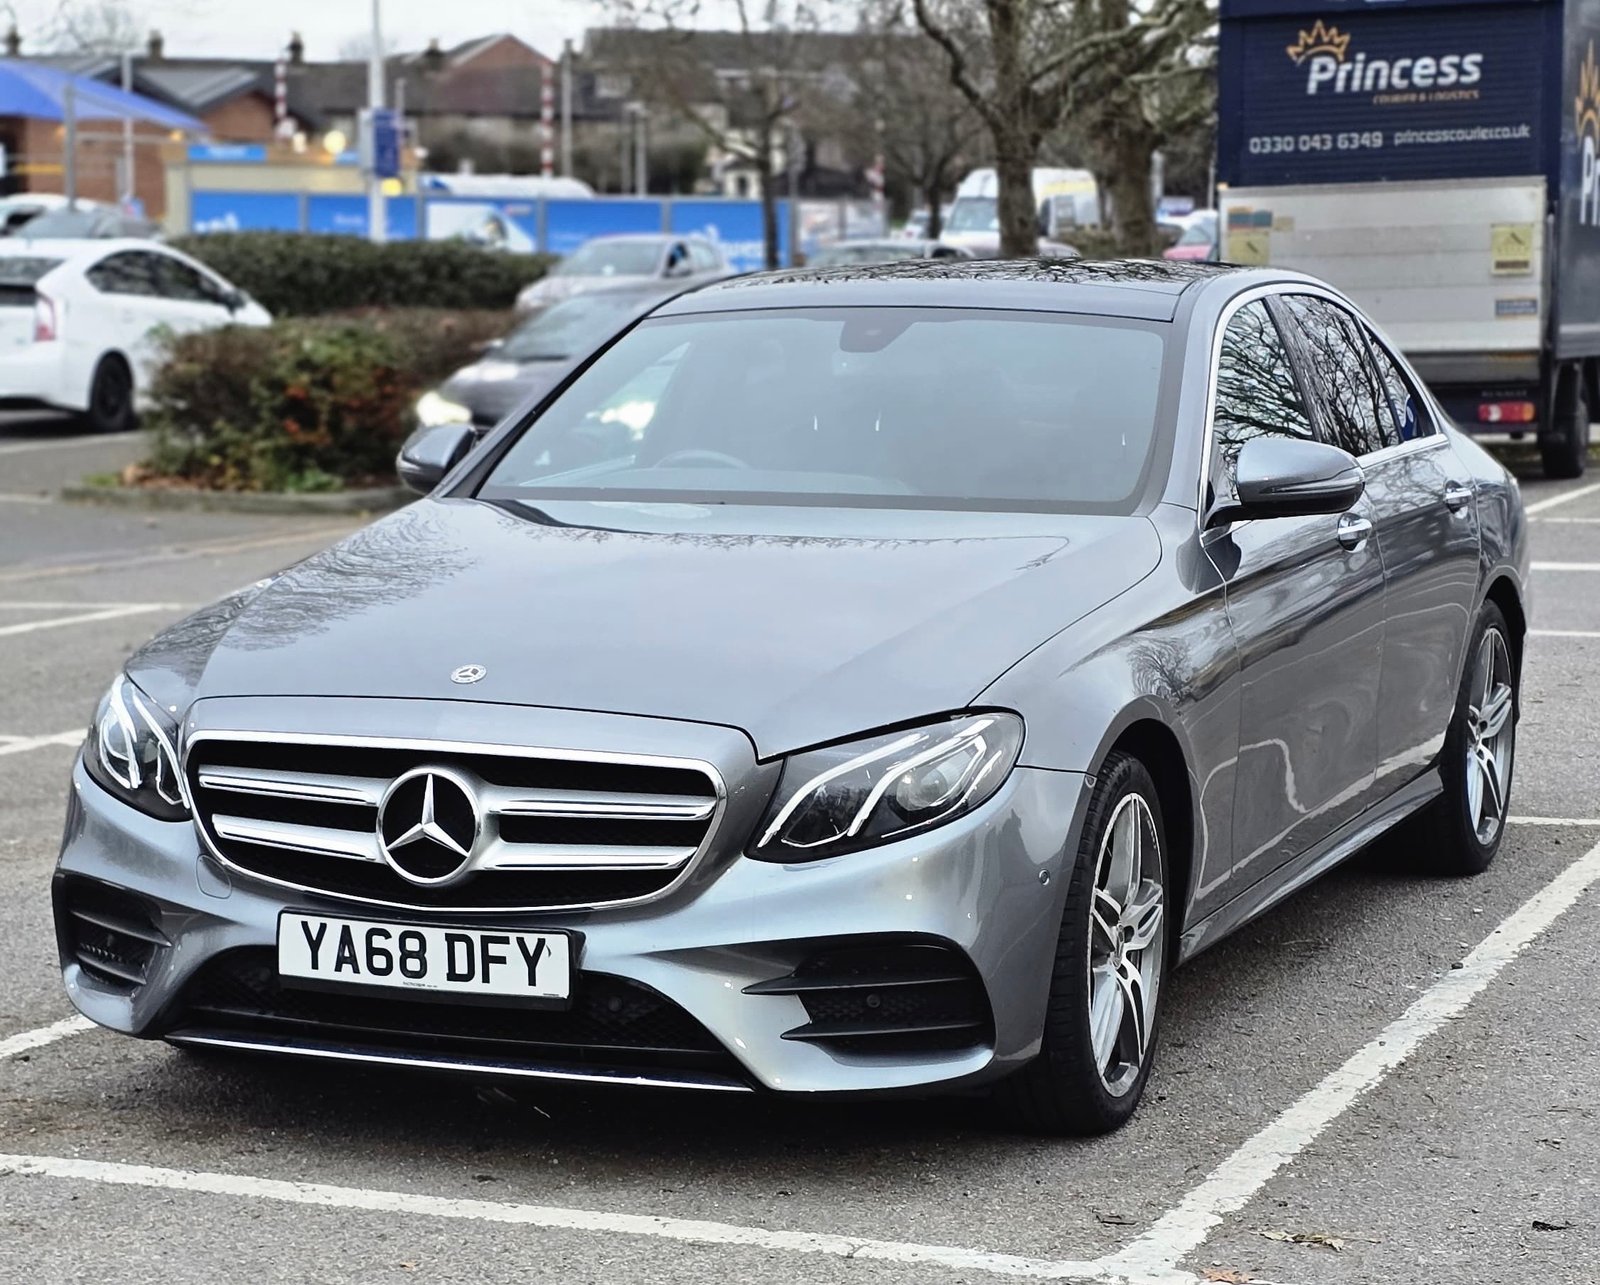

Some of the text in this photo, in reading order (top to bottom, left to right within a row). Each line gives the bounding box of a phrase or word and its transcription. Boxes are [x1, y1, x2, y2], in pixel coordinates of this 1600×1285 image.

[1306, 52, 1483, 94] Princess
[1250, 131, 1383, 154] 0330 043 6349
[300, 919, 546, 987] YA68 DFY
